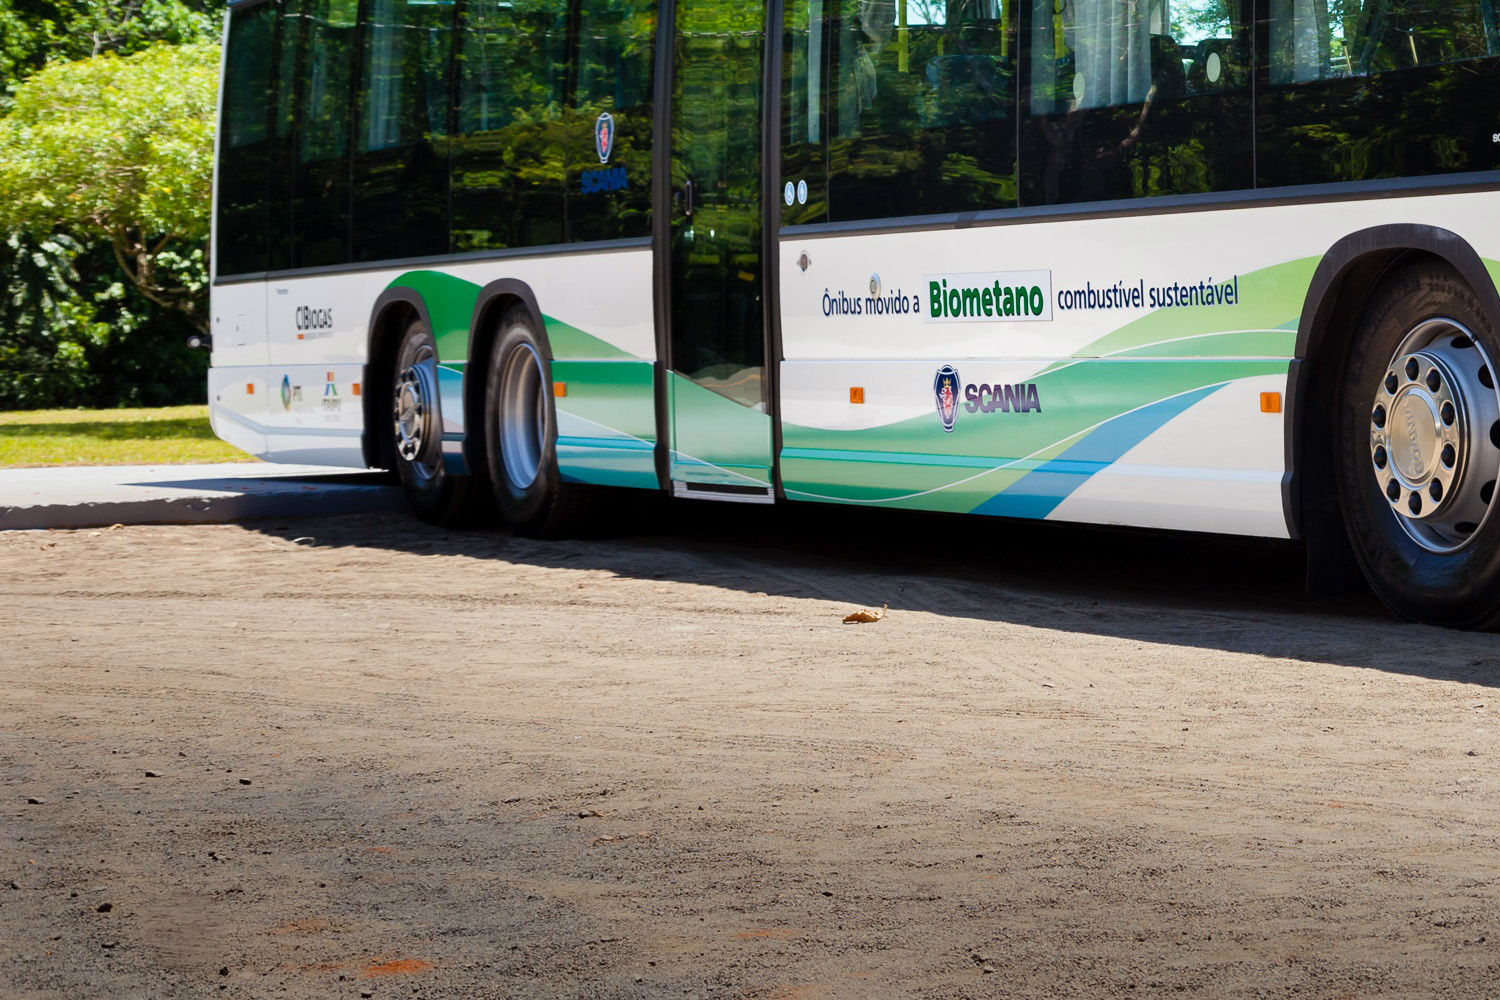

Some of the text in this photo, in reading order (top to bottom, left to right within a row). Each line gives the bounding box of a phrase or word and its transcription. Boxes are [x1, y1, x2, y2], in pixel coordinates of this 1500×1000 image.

[580, 167, 628, 194] SCANIA
[822, 275, 1239, 318] Ônibus movido a Biometano combustível sustentável
[964, 383, 1042, 414] SCANIA
